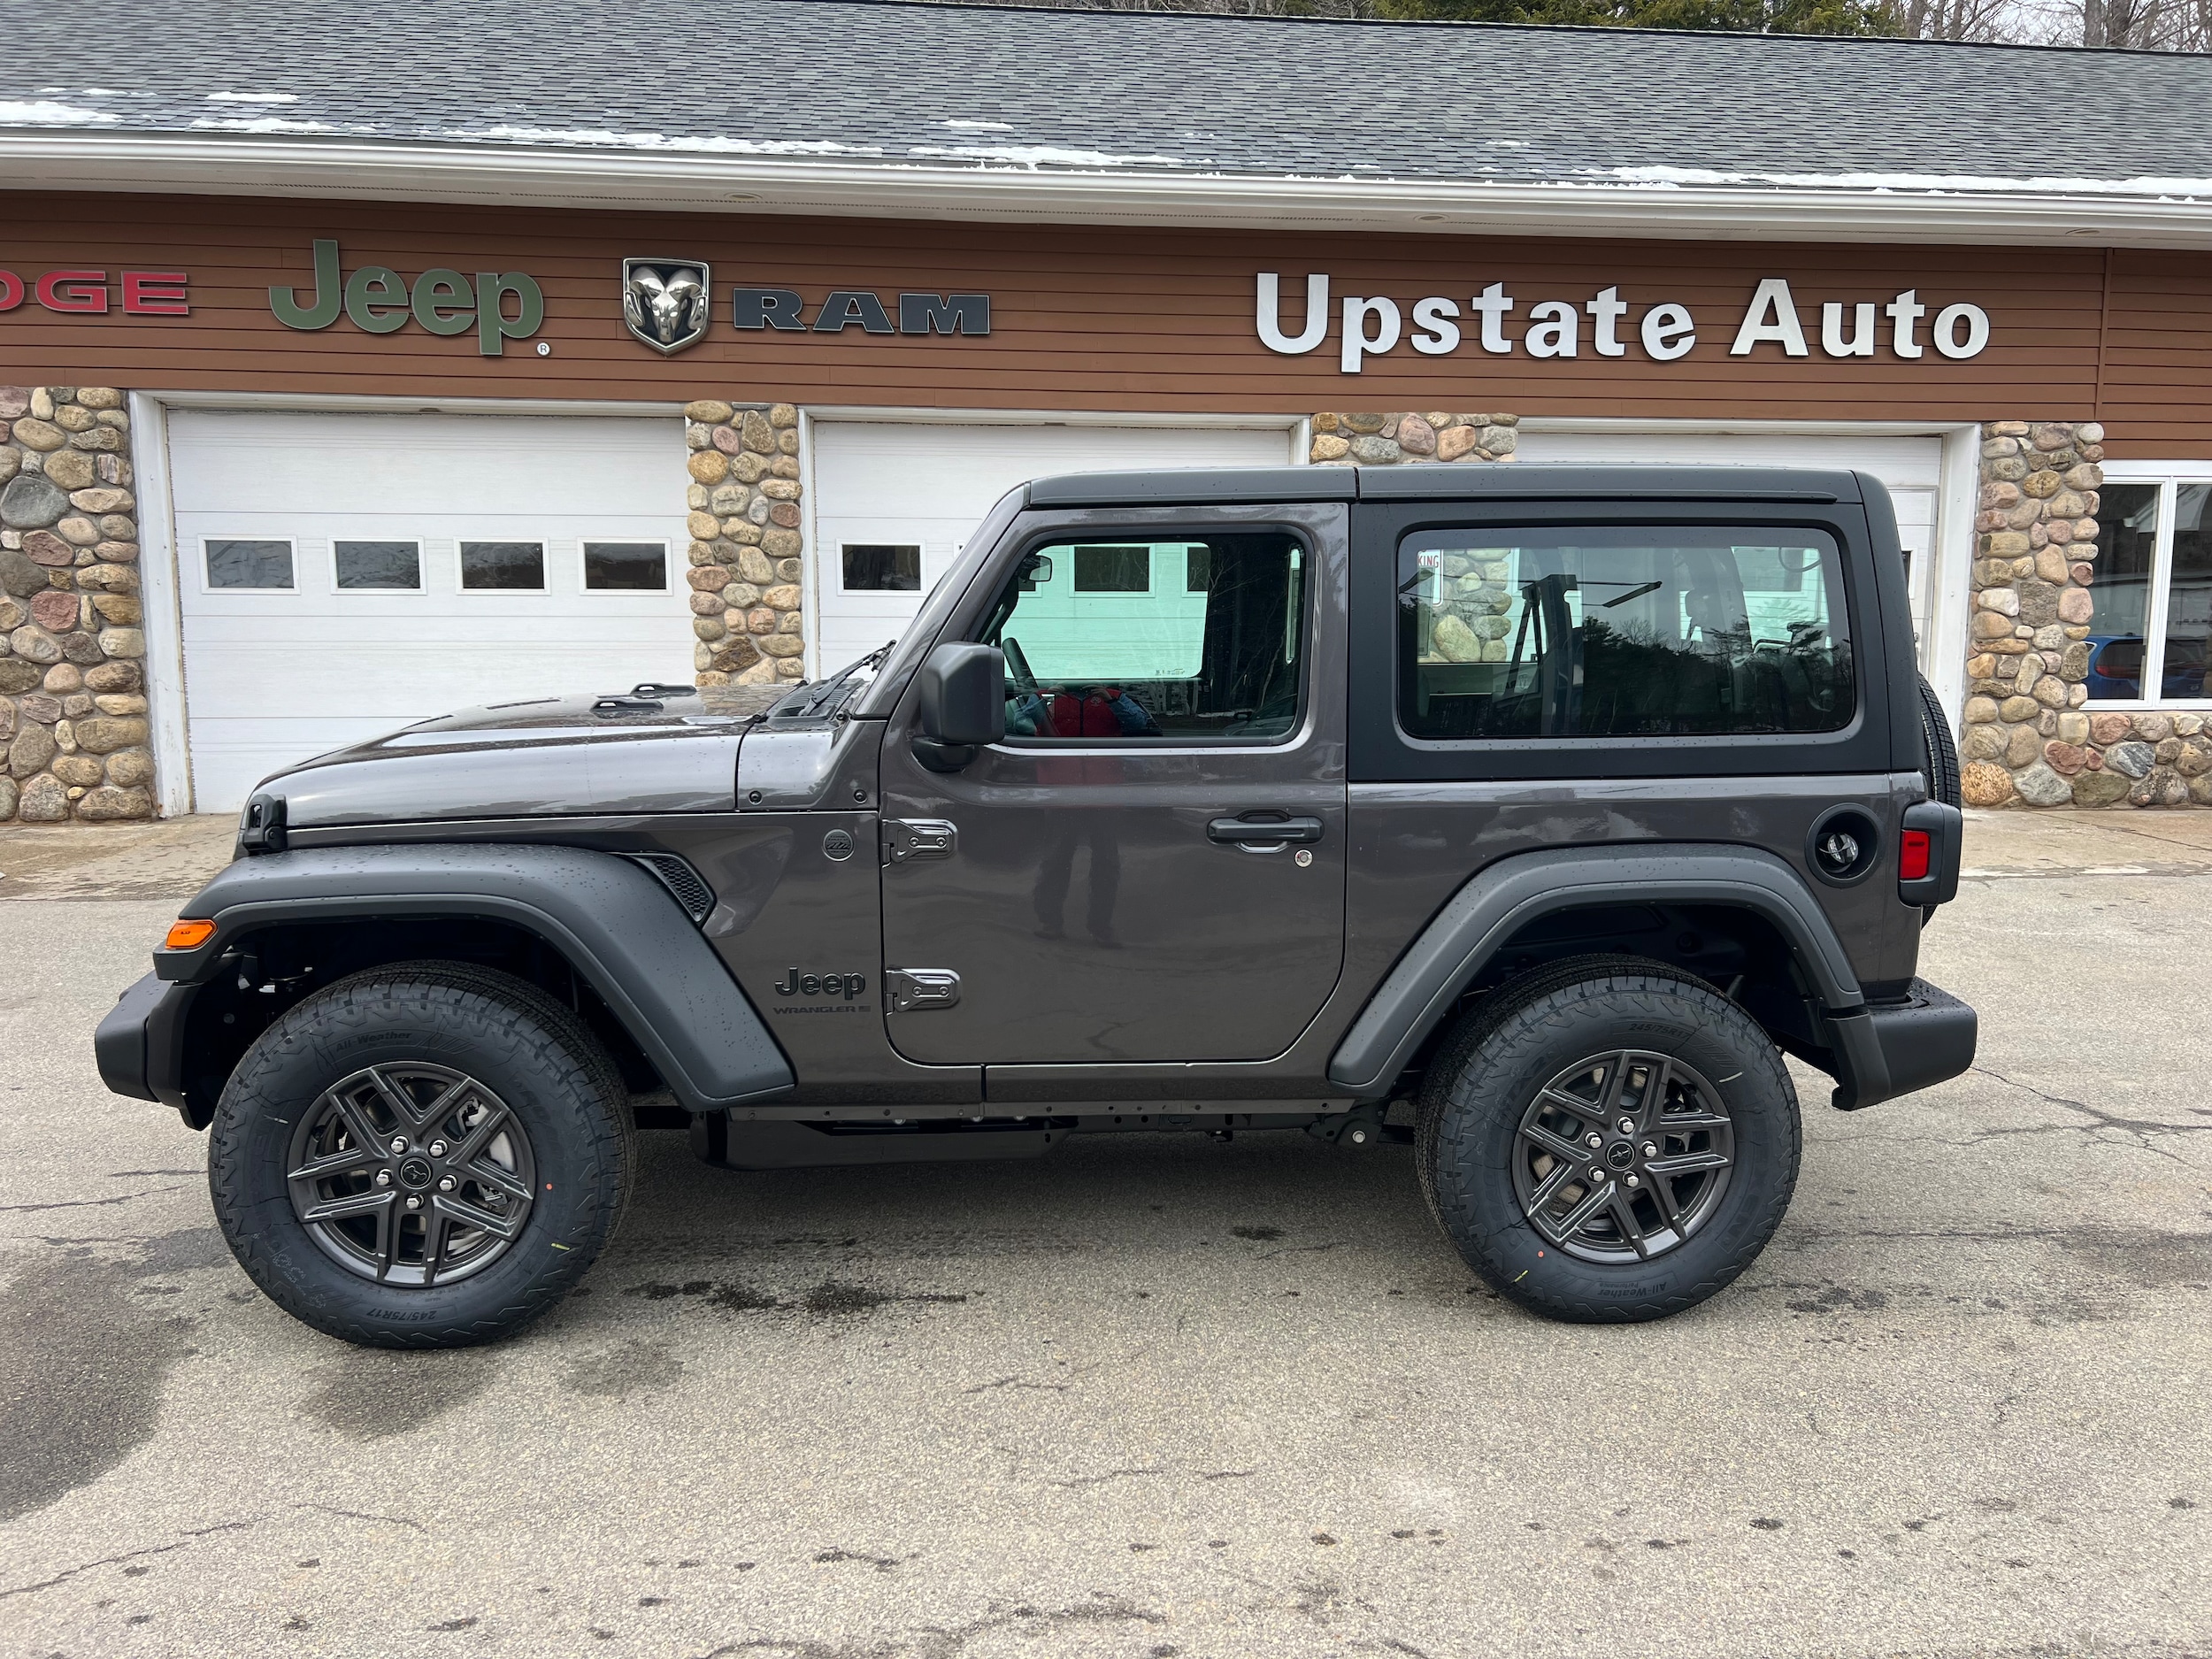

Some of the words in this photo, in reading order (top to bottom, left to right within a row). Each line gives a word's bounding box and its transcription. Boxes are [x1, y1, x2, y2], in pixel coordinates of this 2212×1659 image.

[268, 238, 544, 356] Jeep
[733, 288, 991, 334] RAM
[1256, 272, 1697, 373] Upstate
[1729, 277, 1991, 359] Auto
[1417, 555, 1439, 568] KING
[774, 965, 866, 1001] Jeep
[772, 1005, 856, 1015] WRANGLER
[335, 1031, 412, 1053] All-Weather
[1628, 1023, 1691, 1041] 245/75R17
[1596, 1281, 1668, 1298] All-Weather
[365, 1307, 438, 1322] 245/75R17
